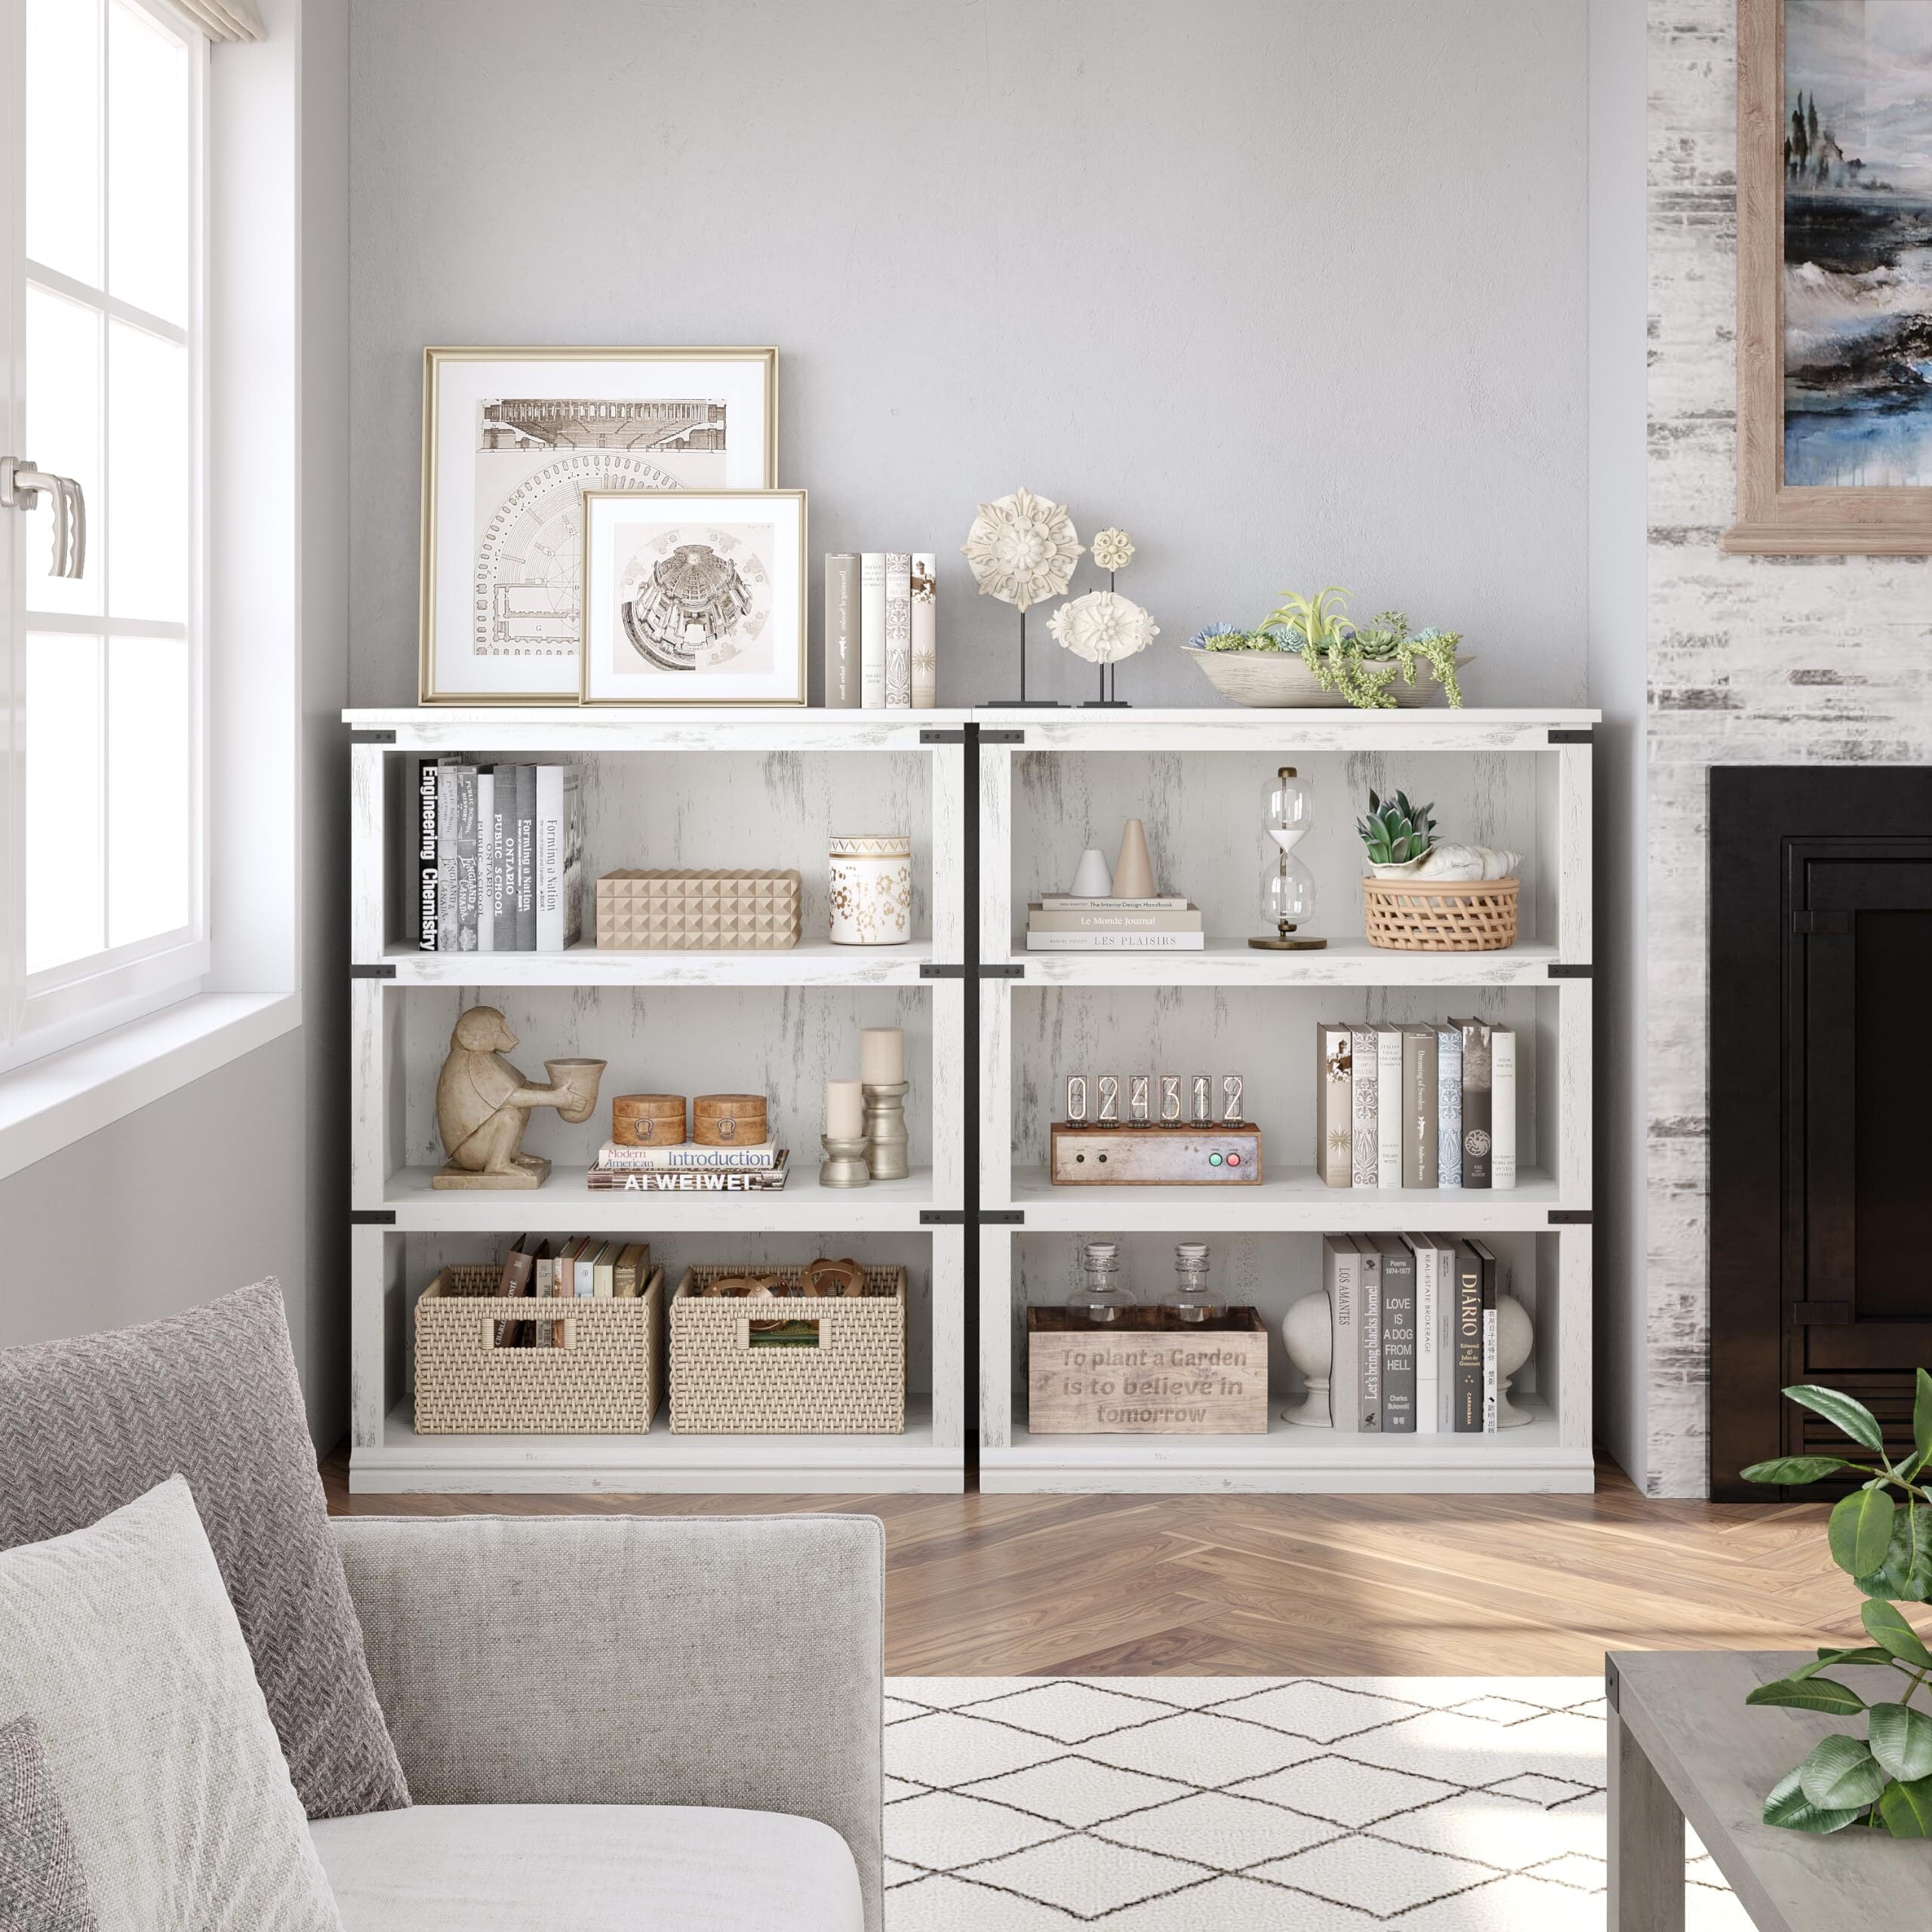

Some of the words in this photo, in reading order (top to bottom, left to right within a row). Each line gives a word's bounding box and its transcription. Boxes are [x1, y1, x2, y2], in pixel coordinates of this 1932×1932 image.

[465, 780, 473, 805] PUBLIC
[420, 766, 438, 860] Engineering
[465, 807, 474, 834] SCHOOL
[522, 820, 532, 865] Forming
[546, 820, 558, 865] Forming
[506, 838, 514, 895] ONTARIO
[458, 856, 477, 903] ENGLAND
[523, 876, 532, 912] Nation
[547, 877, 558, 911] Nation
[420, 868, 438, 951] Chemistry
[1094, 937, 1115, 945] LES
[1121, 937, 1177, 945] PLAISIRS
[1417, 1050, 1426, 1080] Dreaming
[605, 1159, 654, 1168] American
[608, 1149, 646, 1158] Modern
[669, 1151, 771, 1166] Introduction
[624, 1174, 652, 1190] AI
[656, 1174, 750, 1190] WEIWEI
[1339, 1267, 1350, 1284] LOS
[1339, 1285, 1350, 1326] AMANTES
[1364, 1285, 1377, 1316] home!
[1386, 1299, 1411, 1309] LOVE
[1461, 1274, 1481, 1336] DIÁRIO
[1394, 1314, 1403, 1324] IS
[1364, 1318, 1377, 1348] blacks
[1384, 1329, 1391, 1339] A
[1392, 1329, 1413, 1339] DOG
[1061, 1349, 1086, 1366] To
[1092, 1349, 1147, 1371] plant
[1152, 1354, 1164, 1366] a
[1170, 1349, 1247, 1366] Garden
[1364, 1349, 1380, 1375] bring
[1385, 1344, 1412, 1355] FROM
[1387, 1360, 1410, 1370] HELL
[1063, 1377, 1081, 1395] is
[1091, 1378, 1115, 1395] to
[1123, 1377, 1212, 1395] believe
[1220, 1377, 1243, 1395] in
[1097, 1405, 1206, 1423] tomorrow
